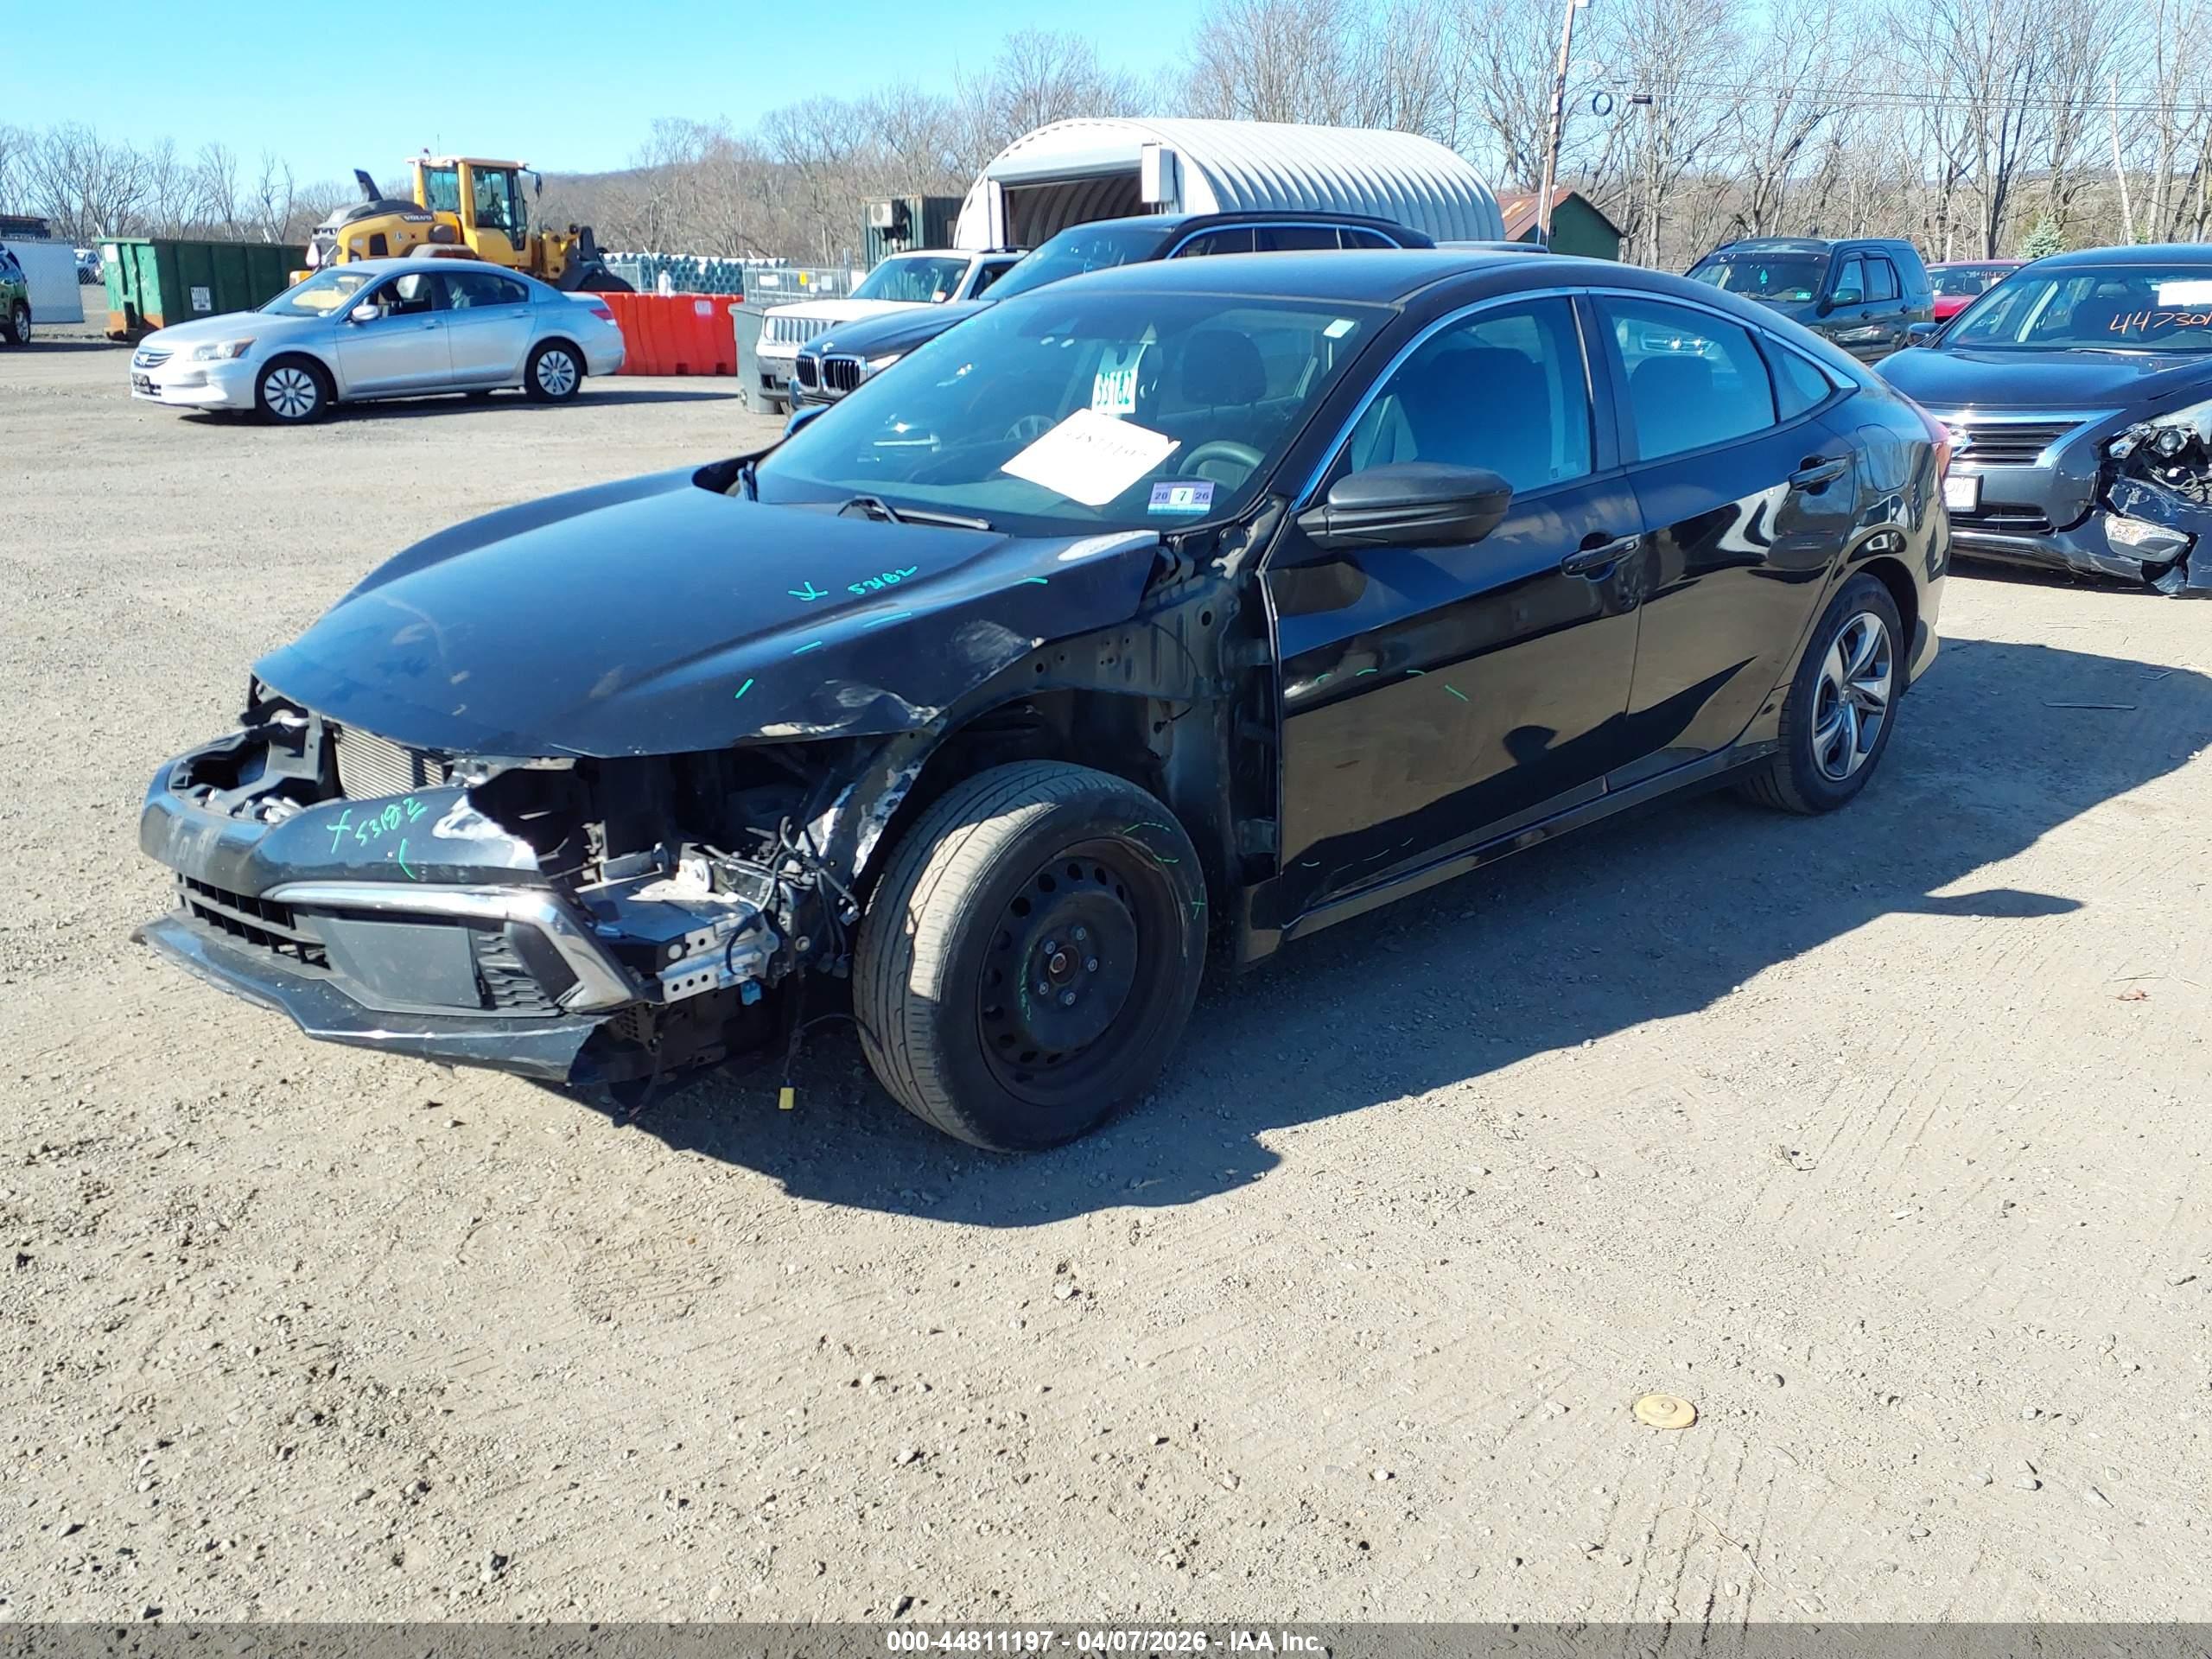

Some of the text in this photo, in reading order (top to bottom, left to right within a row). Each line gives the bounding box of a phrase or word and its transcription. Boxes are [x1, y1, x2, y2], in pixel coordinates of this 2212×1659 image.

[1155, 490, 1209, 502] 20 7 26
